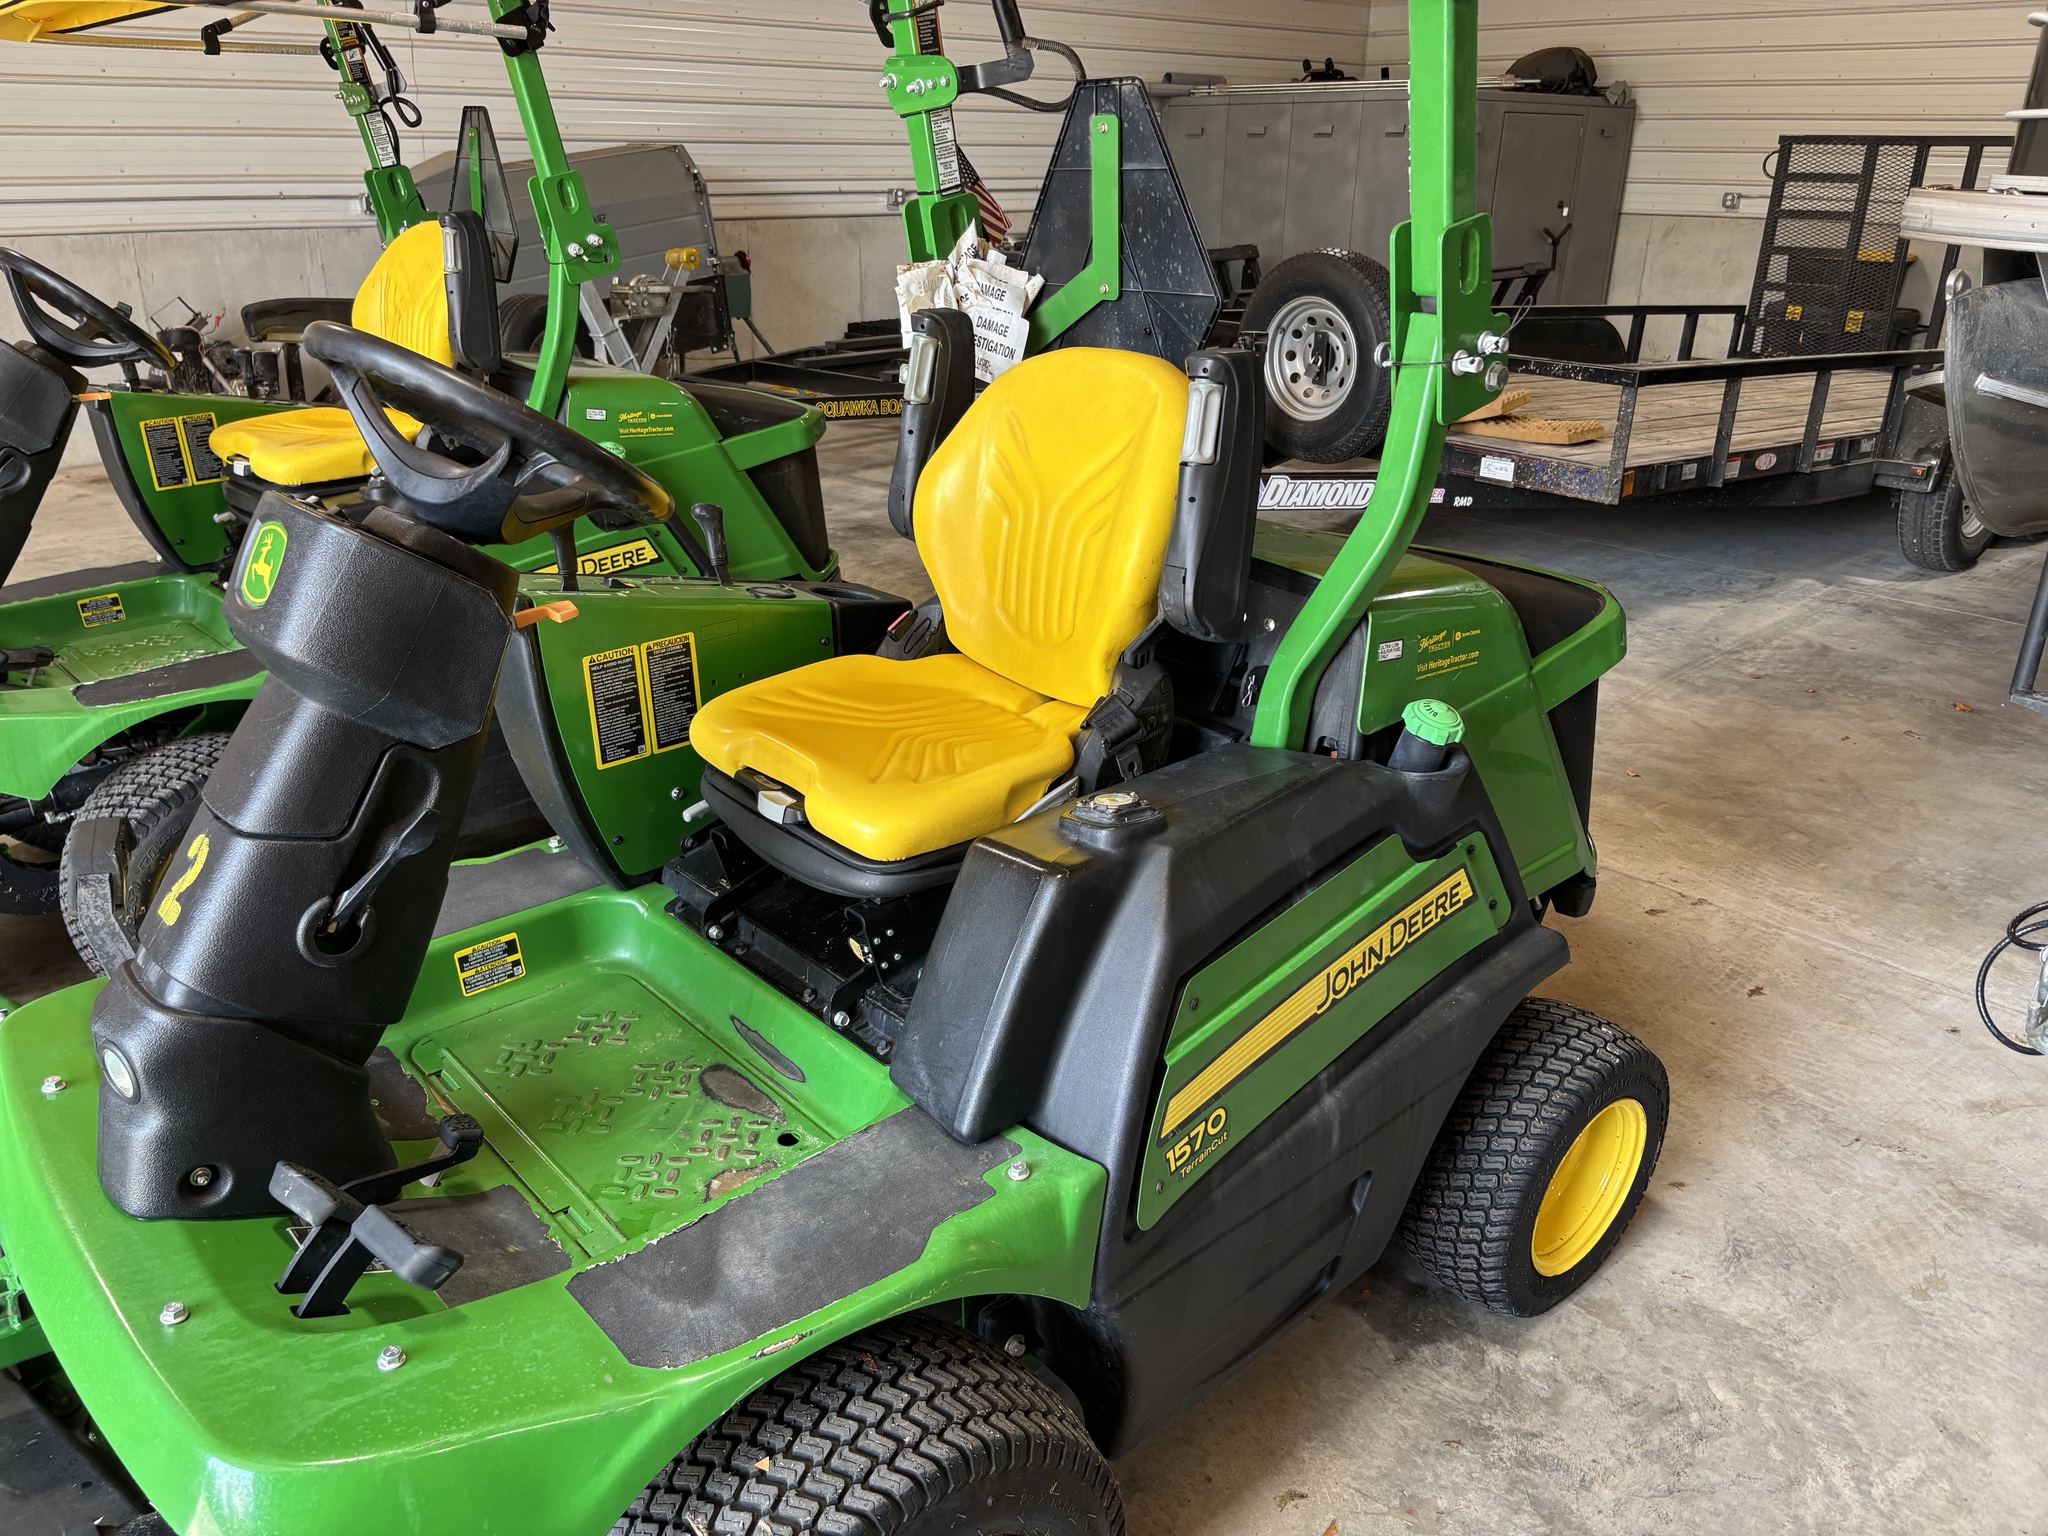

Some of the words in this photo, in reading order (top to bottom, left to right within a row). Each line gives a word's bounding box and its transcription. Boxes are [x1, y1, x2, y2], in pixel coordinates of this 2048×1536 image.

[977, 282, 1007, 302] AMAGE
[976, 316, 1009, 338] DAMAGE
[1258, 476, 1377, 508] DIAMOND
[1453, 496, 1473, 507] RMD
[581, 546, 648, 575] DEERE
[596, 647, 634, 663] CAUTION
[1416, 663, 1428, 673] Visit
[1429, 651, 1479, 670] HeritageTractor.com
[157, 833, 210, 926] 2
[476, 939, 501, 951] CAUTION
[1317, 938, 1383, 1010] JOHN
[1390, 881, 1461, 953] DEERE
[1166, 1108, 1226, 1173] 1570
[1180, 1131, 1228, 1178] TerrainCut
